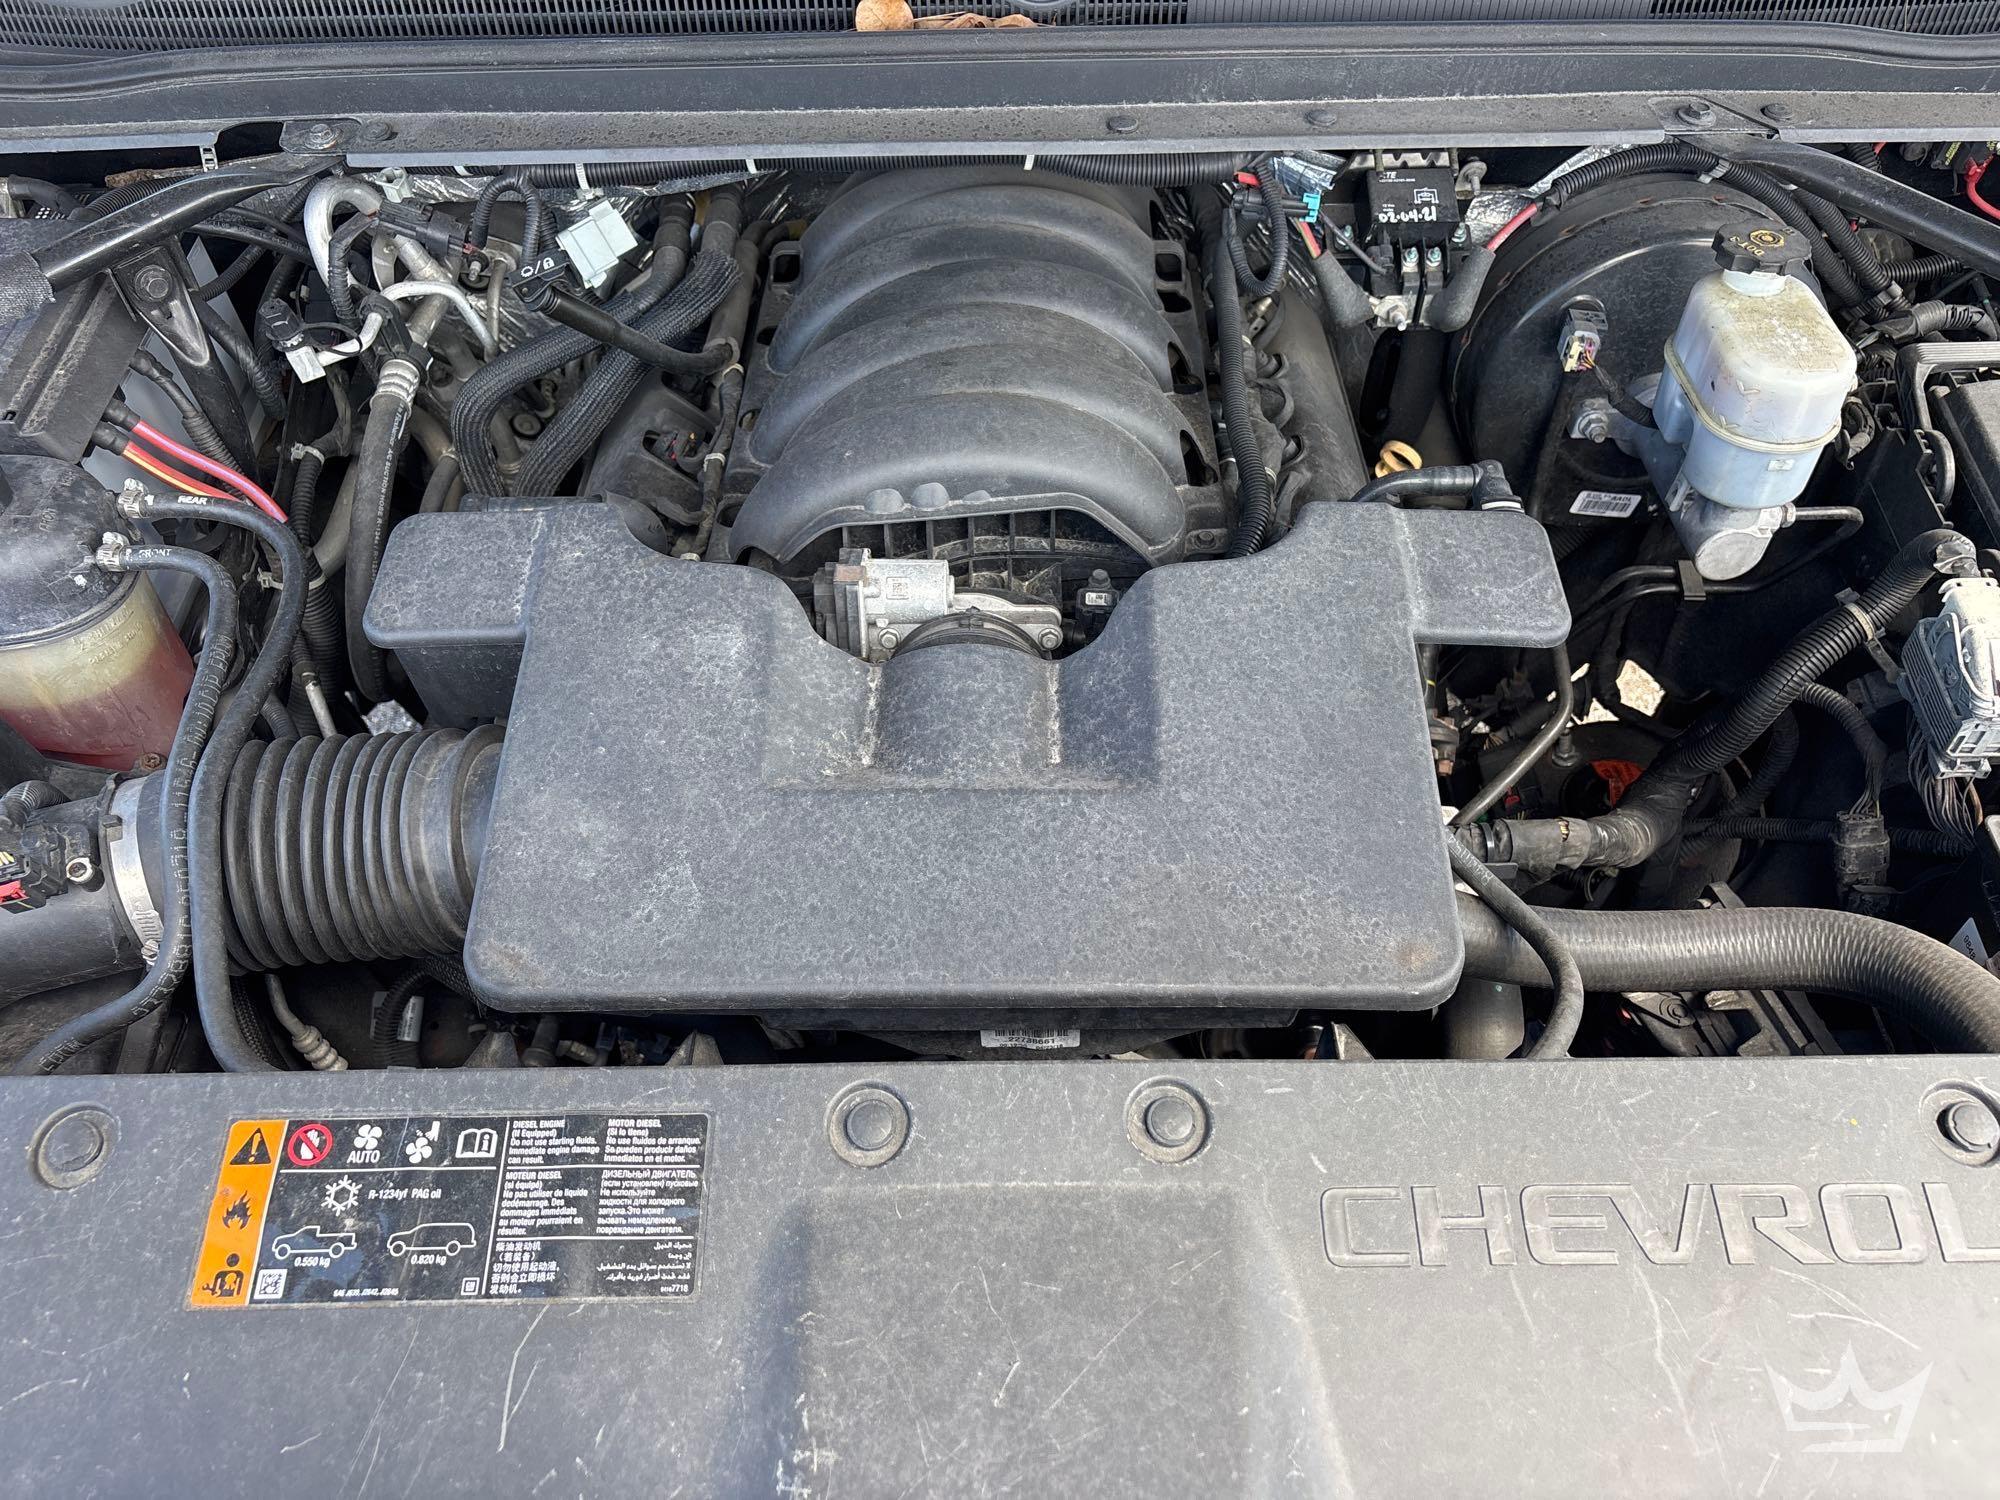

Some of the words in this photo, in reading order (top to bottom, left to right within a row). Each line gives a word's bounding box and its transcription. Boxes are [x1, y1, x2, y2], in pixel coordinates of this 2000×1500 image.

[1738, 242, 1765, 256] DOT
[380, 461, 391, 494] SUCTION
[177, 495, 208, 505] REAR
[377, 494, 385, 517] HOSE
[513, 1120, 538, 1129] DIESEL
[540, 1119, 565, 1128] ENGINE
[608, 1119, 635, 1127] MOTOR
[636, 1119, 661, 1127] DIESEL
[521, 1128, 557, 1138] Equipped)
[510, 1138, 520, 1146] Do
[522, 1138, 534, 1146] not
[549, 1137, 574, 1146] starting
[576, 1136, 597, 1145] fluids.
[668, 1137, 701, 1145] arranque.
[509, 1146, 546, 1155] Immediate
[547, 1147, 570, 1155] engine
[571, 1146, 600, 1154] damage
[605, 1145, 615, 1153] Se
[616, 1146, 642, 1154] pueden
[644, 1146, 674, 1154] producir
[675, 1145, 696, 1153] daños
[347, 1150, 380, 1163] AUTO
[522, 1155, 544, 1164] result.
[505, 1171, 536, 1180] MOTEUR
[538, 1171, 562, 1179] DIESEL
[602, 1169, 650, 1179] ДИЗЕЛЬНЫЙ
[515, 1181, 543, 1190] équipé)
[601, 1180, 620, 1188] (если
[622, 1180, 665, 1188] установлен)
[368, 1189, 409, 1201] R-1234yf
[411, 1188, 430, 1198] PAG
[430, 1188, 441, 1199] oil
[503, 1190, 513, 1198] Ne
[514, 1191, 527, 1200] pas
[529, 1189, 553, 1198] utiliser
[554, 1189, 563, 1197] de
[564, 1188, 588, 1198] liquide
[600, 1189, 610, 1197] Не
[611, 1189, 656, 1197] используйте
[551, 1198, 565, 1206] Des
[648, 1198, 686, 1206] холодного
[500, 1208, 539, 1217] dommages
[541, 1207, 577, 1215] immédiats
[510, 1218, 535, 1226] moteur
[536, 1217, 572, 1227] pourraient
[1320, 1182, 2000, 1267] CHEVROL
[497, 1227, 526, 1235] résulter.
[496, 1241, 541, 1252] 柴油发动机
[294, 1256, 318, 1267] 0.550
[319, 1256, 331, 1268] kg
[411, 1254, 435, 1265] 0.820
[435, 1255, 446, 1266] kg
